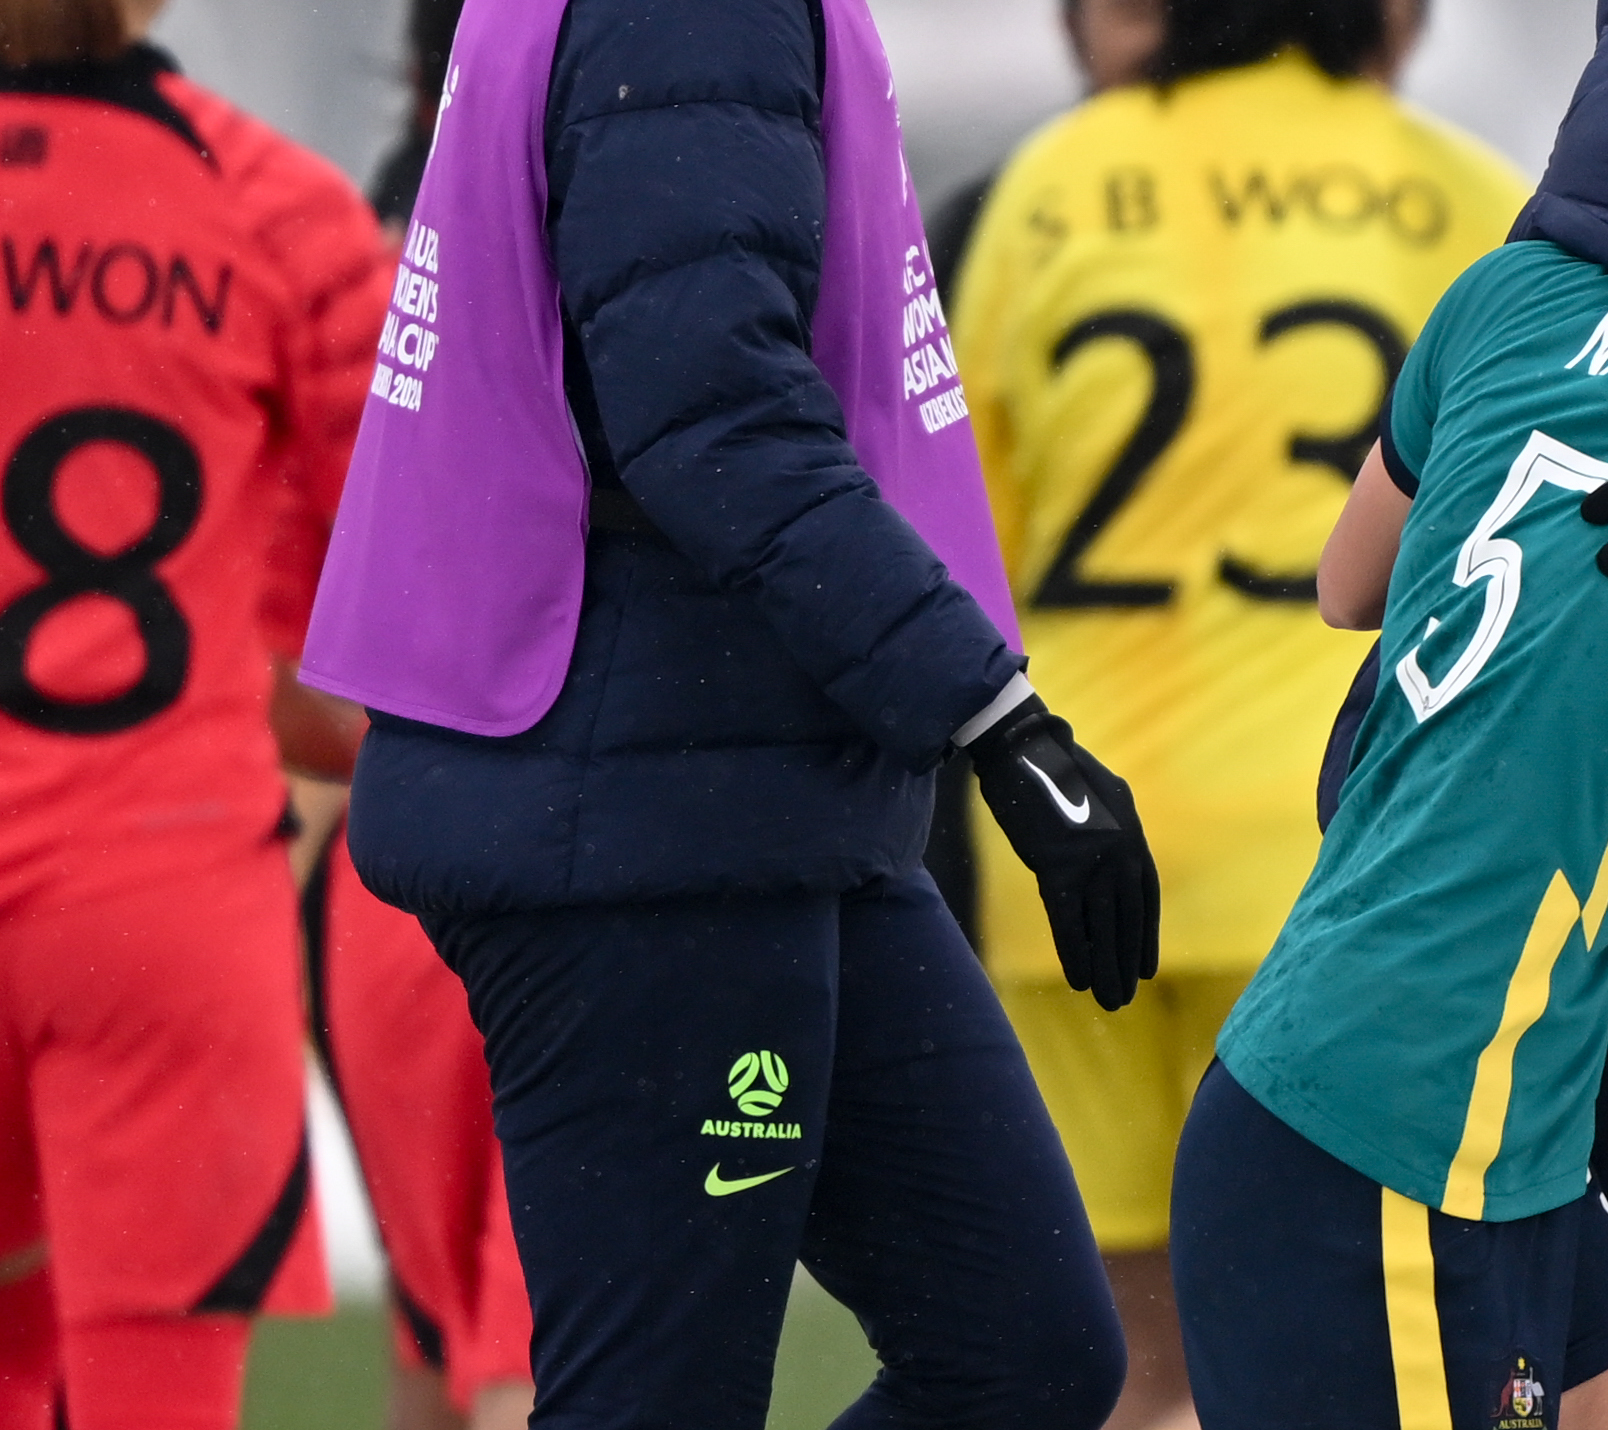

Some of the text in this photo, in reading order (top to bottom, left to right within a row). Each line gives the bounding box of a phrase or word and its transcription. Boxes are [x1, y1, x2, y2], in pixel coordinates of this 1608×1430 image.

[1105, 171, 1159, 234] B
[1209, 168, 1450, 248] WOO
[0, 236, 234, 335] WON
[1028, 295, 1412, 611] 23
[700, 1119, 802, 1139] AUSTRALIA
